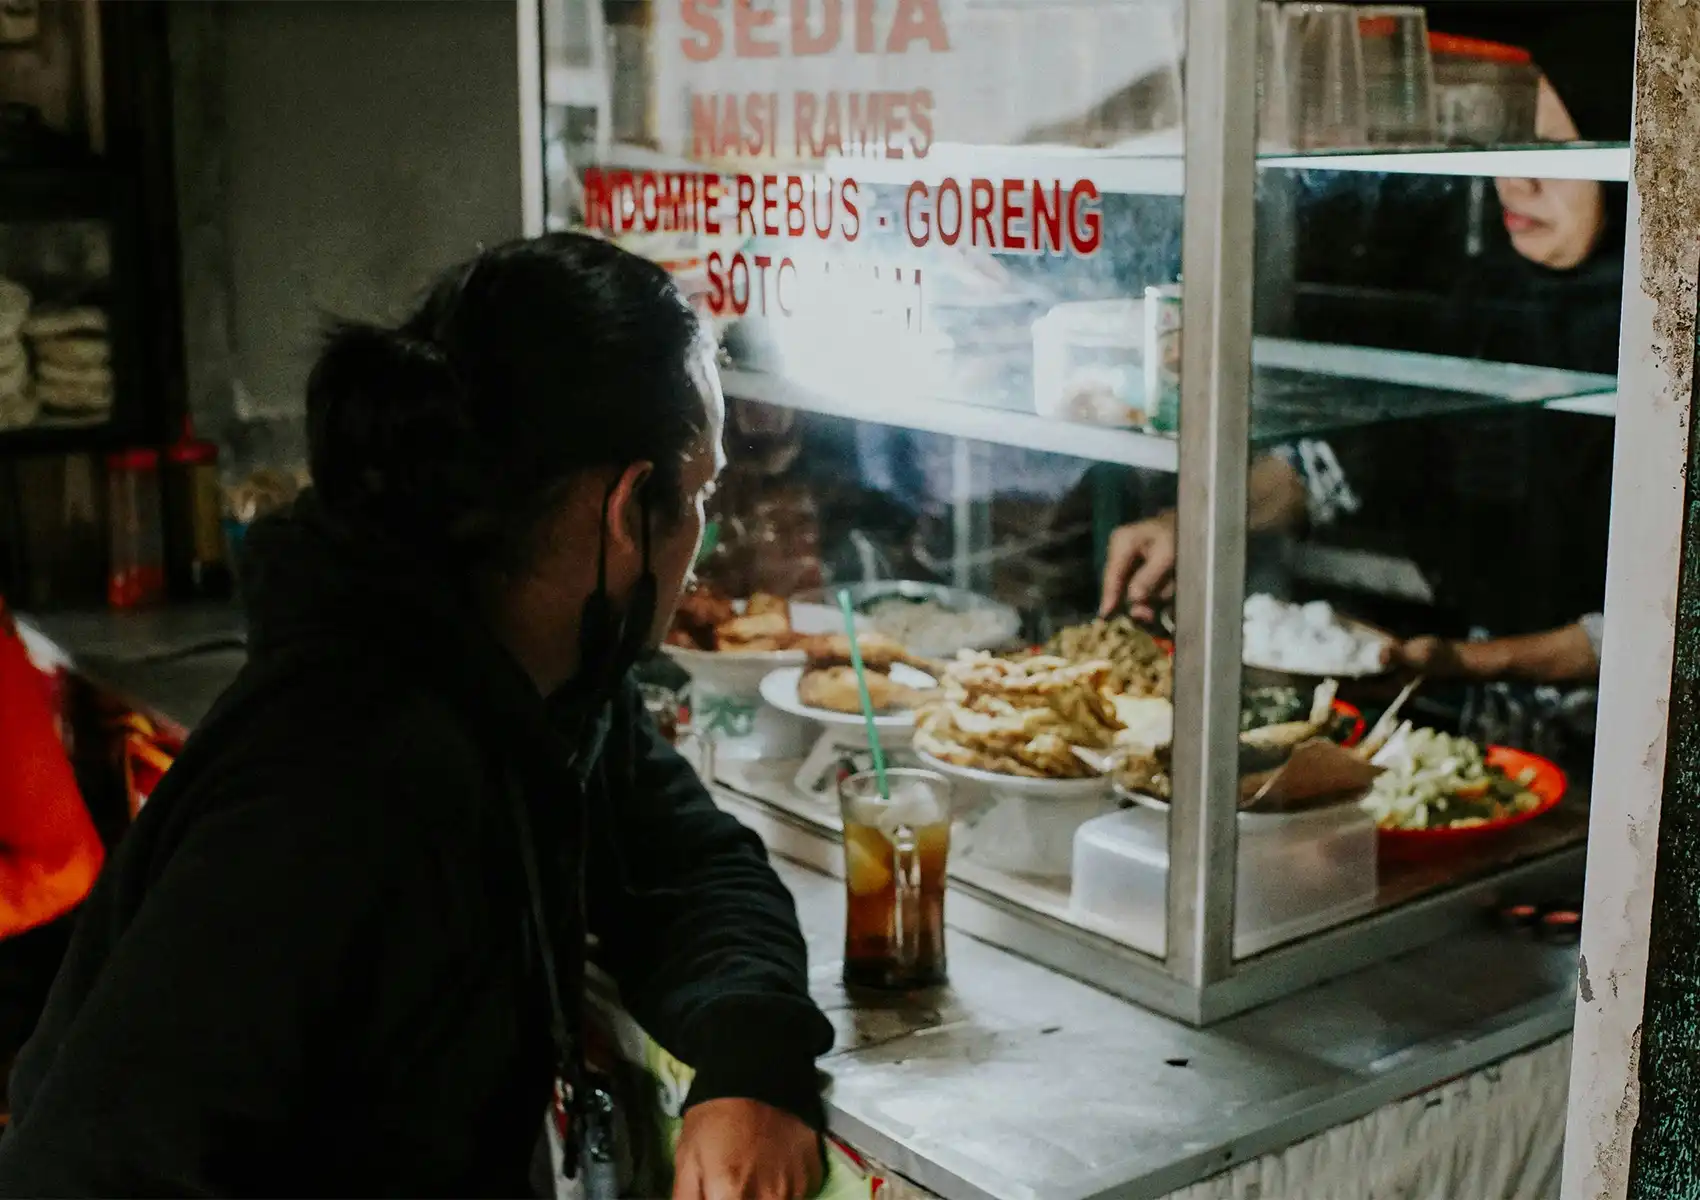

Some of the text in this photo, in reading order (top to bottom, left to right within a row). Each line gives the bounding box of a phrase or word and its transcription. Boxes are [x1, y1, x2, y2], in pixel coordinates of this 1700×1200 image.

[679, 0, 951, 61] SEDIA
[691, 88, 935, 159] NASI RAMES
[584, 169, 720, 236] INDOMIE
[737, 174, 860, 242] REBUS
[906, 178, 1101, 254] GORENG
